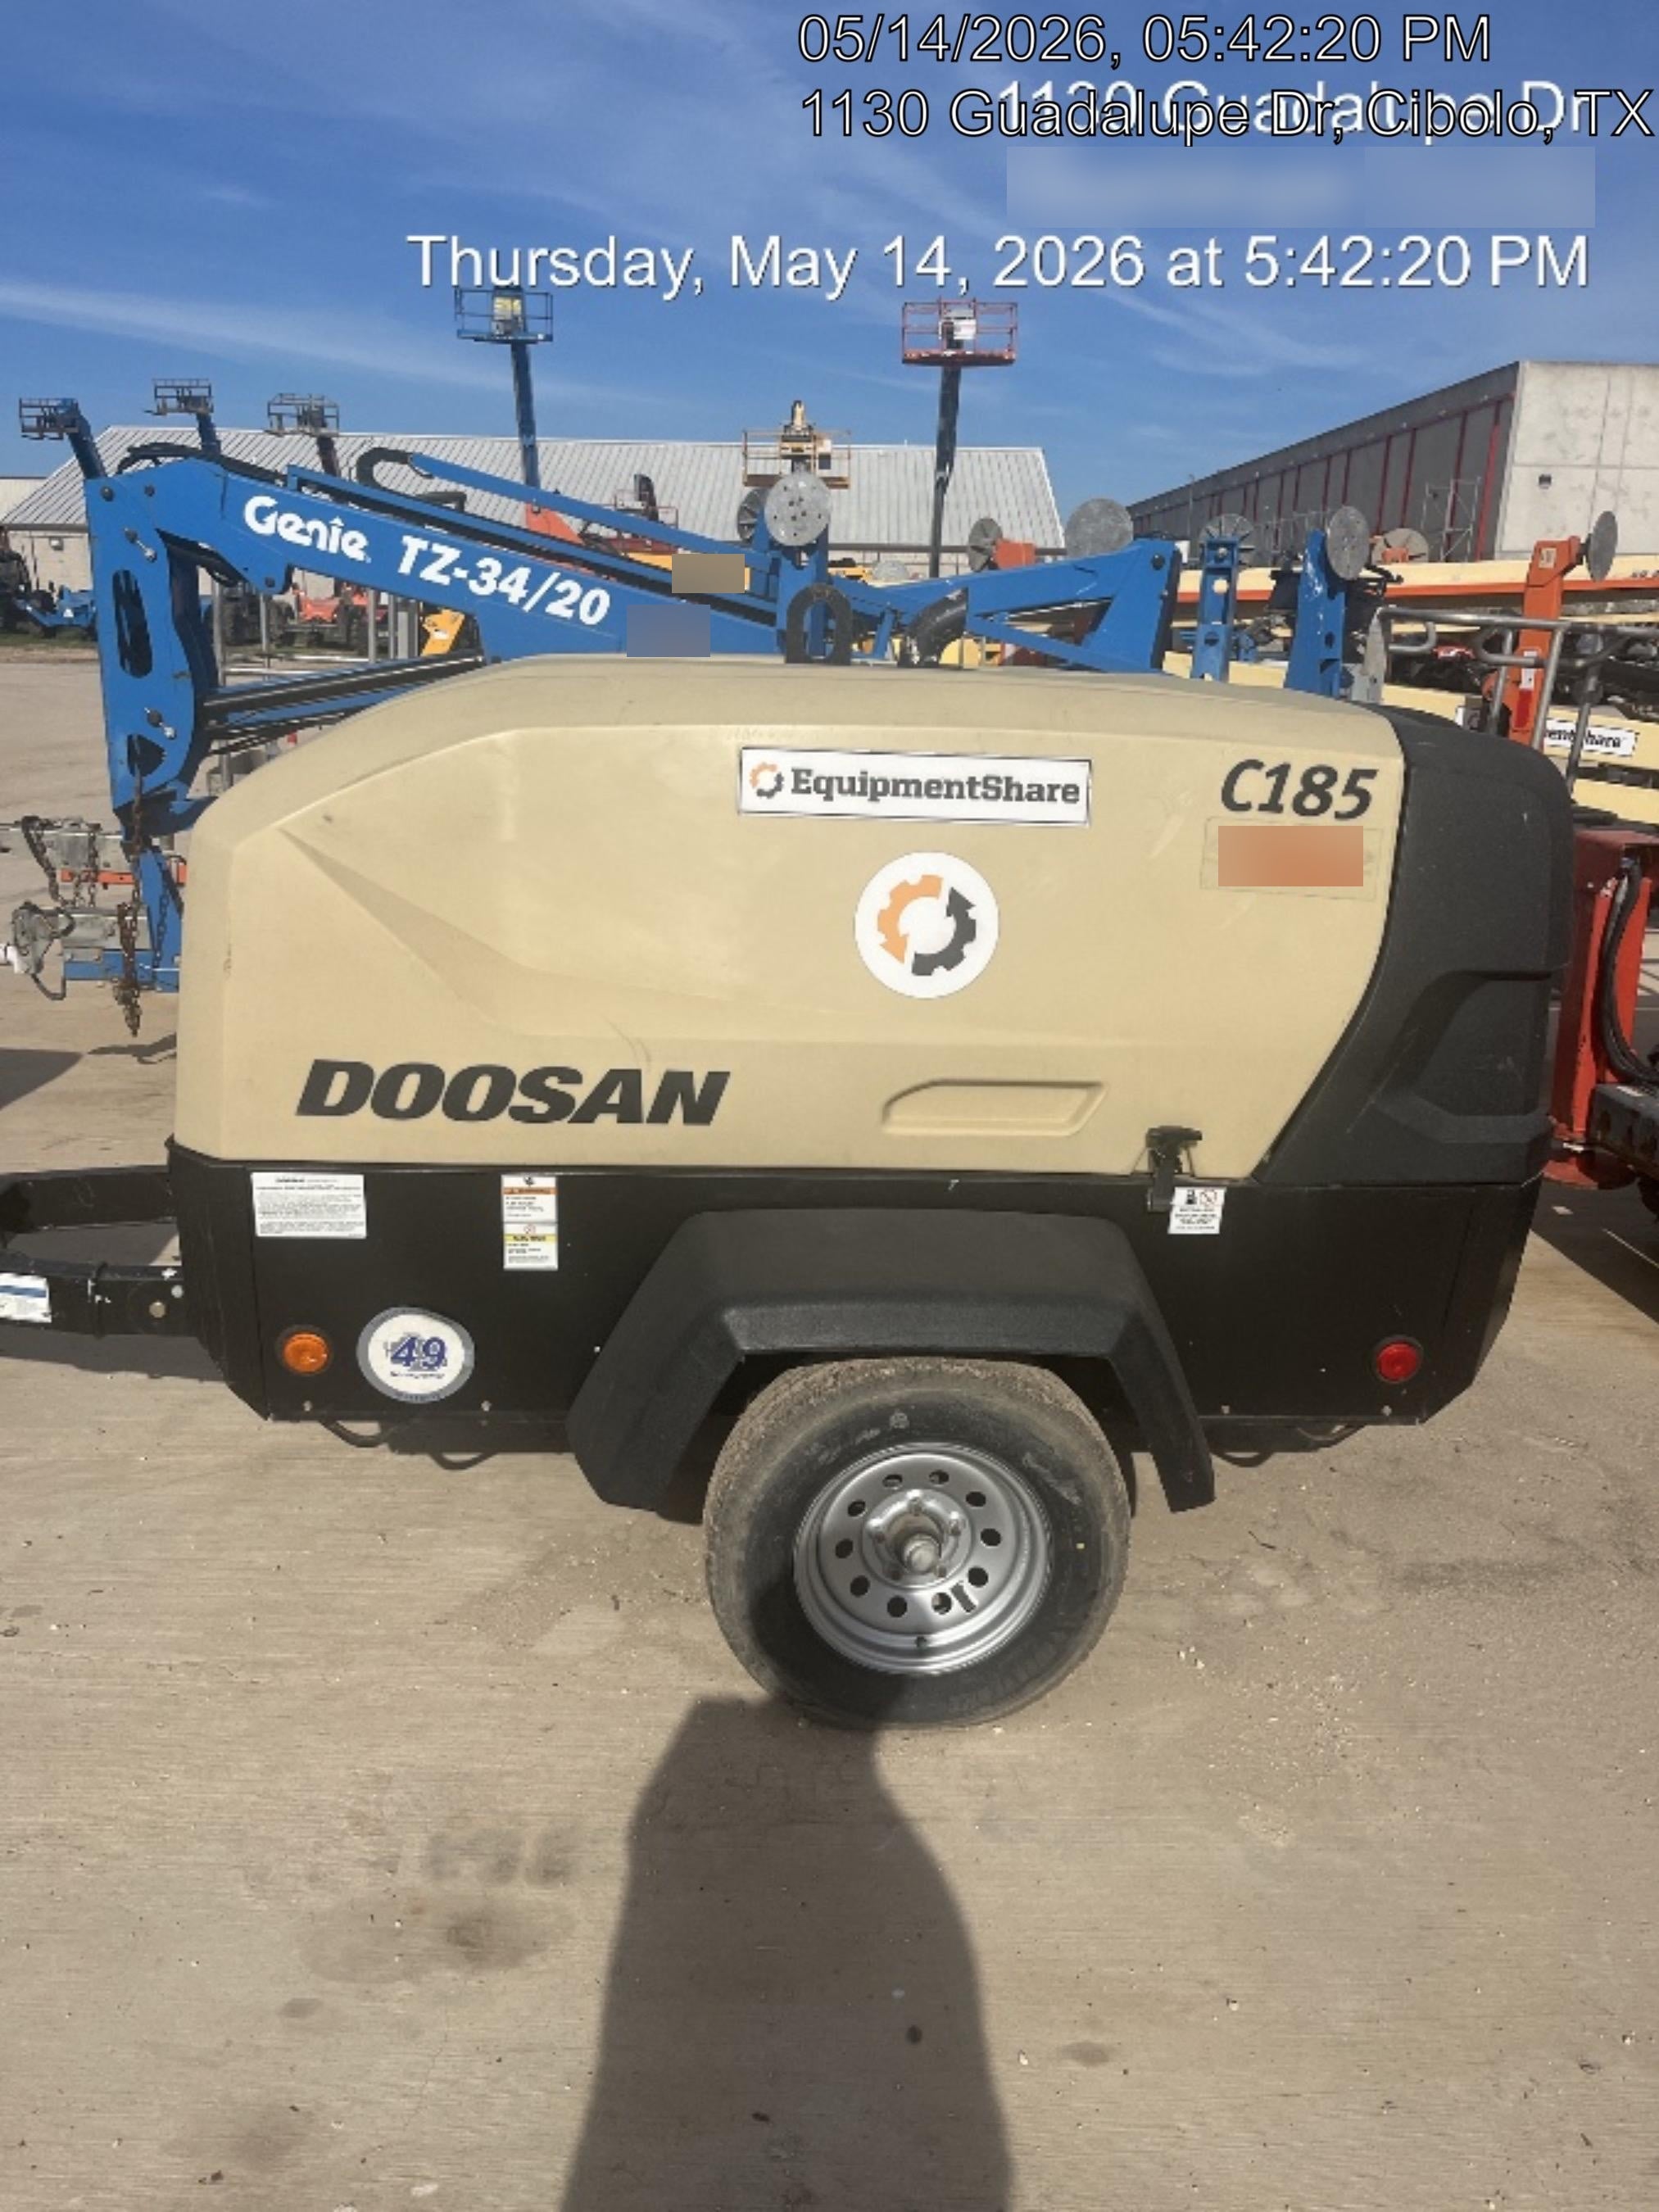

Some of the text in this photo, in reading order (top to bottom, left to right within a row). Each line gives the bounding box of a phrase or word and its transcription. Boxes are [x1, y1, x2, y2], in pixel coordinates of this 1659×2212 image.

[243, 495, 371, 562] Genie
[397, 534, 611, 626] TZ-34/20
[790, 767, 1081, 804] EquipmentShare
[1221, 758, 1380, 821] C185
[295, 1058, 731, 1126] DOOSAN
